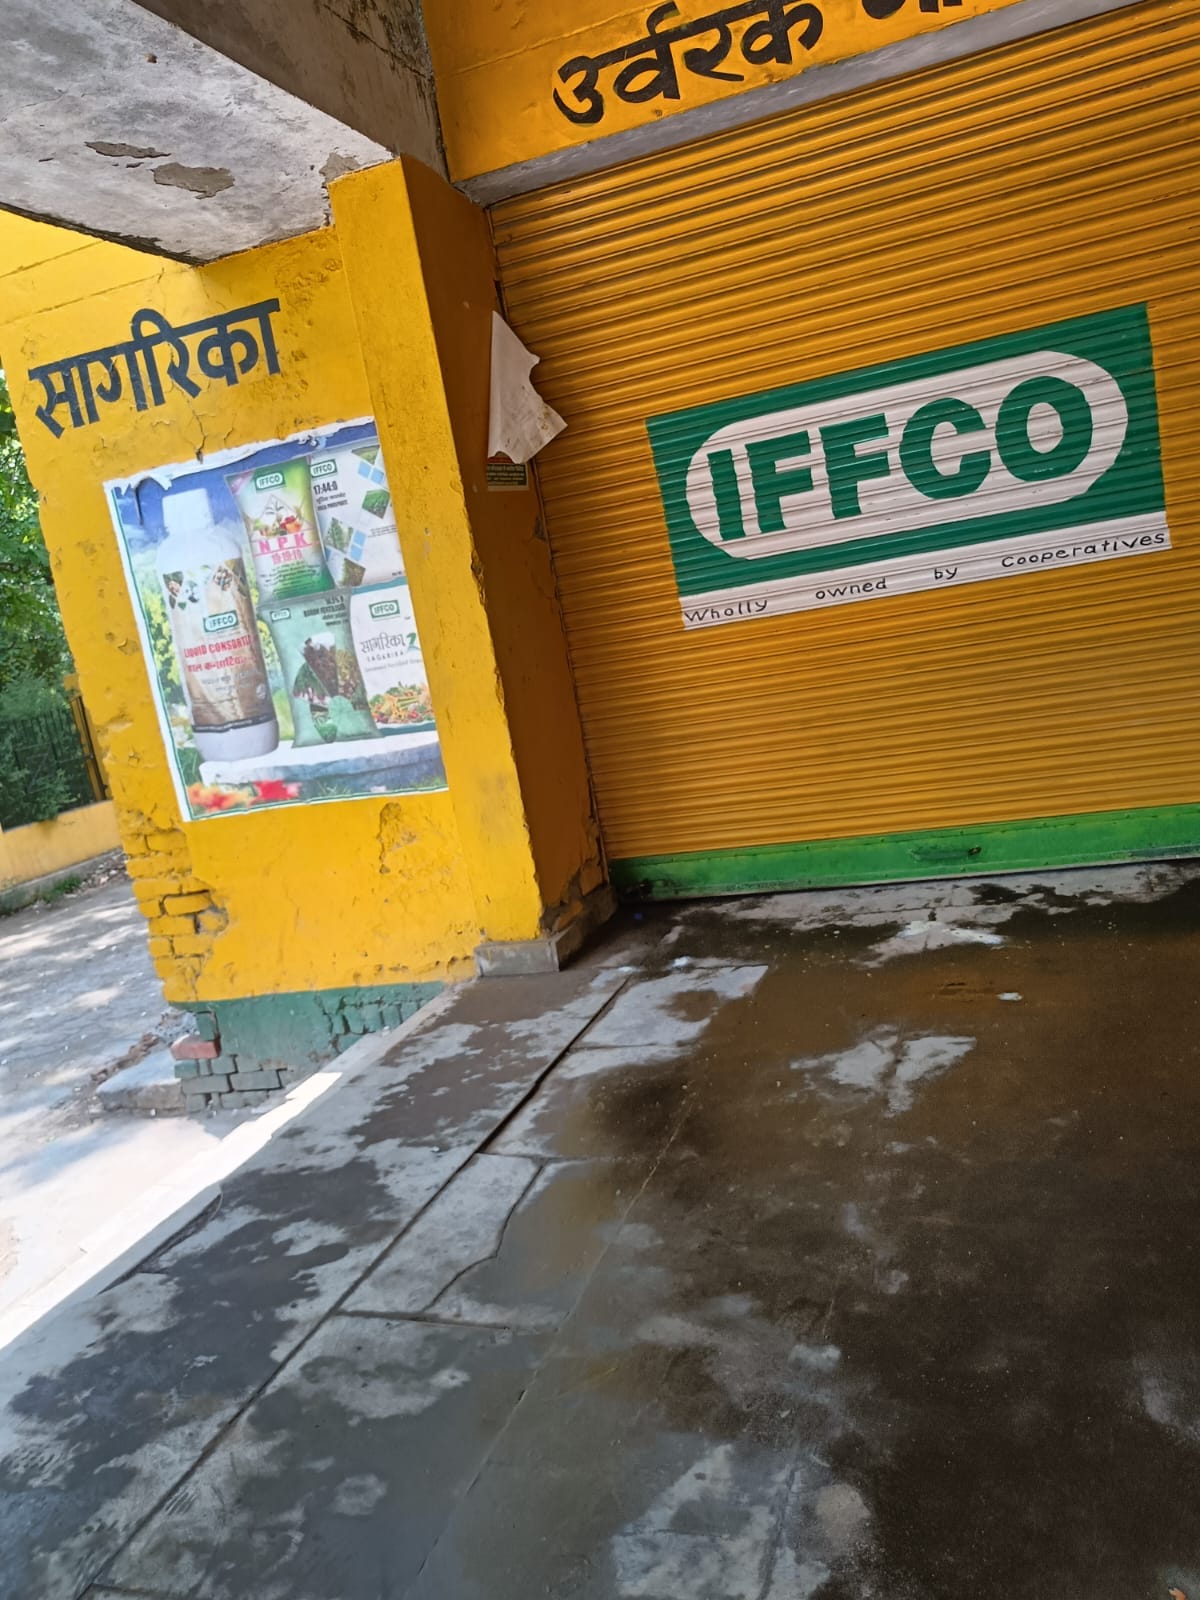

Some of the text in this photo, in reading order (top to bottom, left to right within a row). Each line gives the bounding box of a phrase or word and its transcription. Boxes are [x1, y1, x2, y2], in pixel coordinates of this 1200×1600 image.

[553, 0, 824, 124] उर्वरक
[28, 298, 281, 439] सागरिका
[258, 474, 281, 487] IFFCO
[312, 463, 333, 475] IFFCO
[706, 376, 1093, 541] IFFCO
[684, 531, 1166, 623] Wholly owned by Cooperatives
[209, 615, 234, 629] IFFCO
[373, 603, 395, 614] IFFCO
